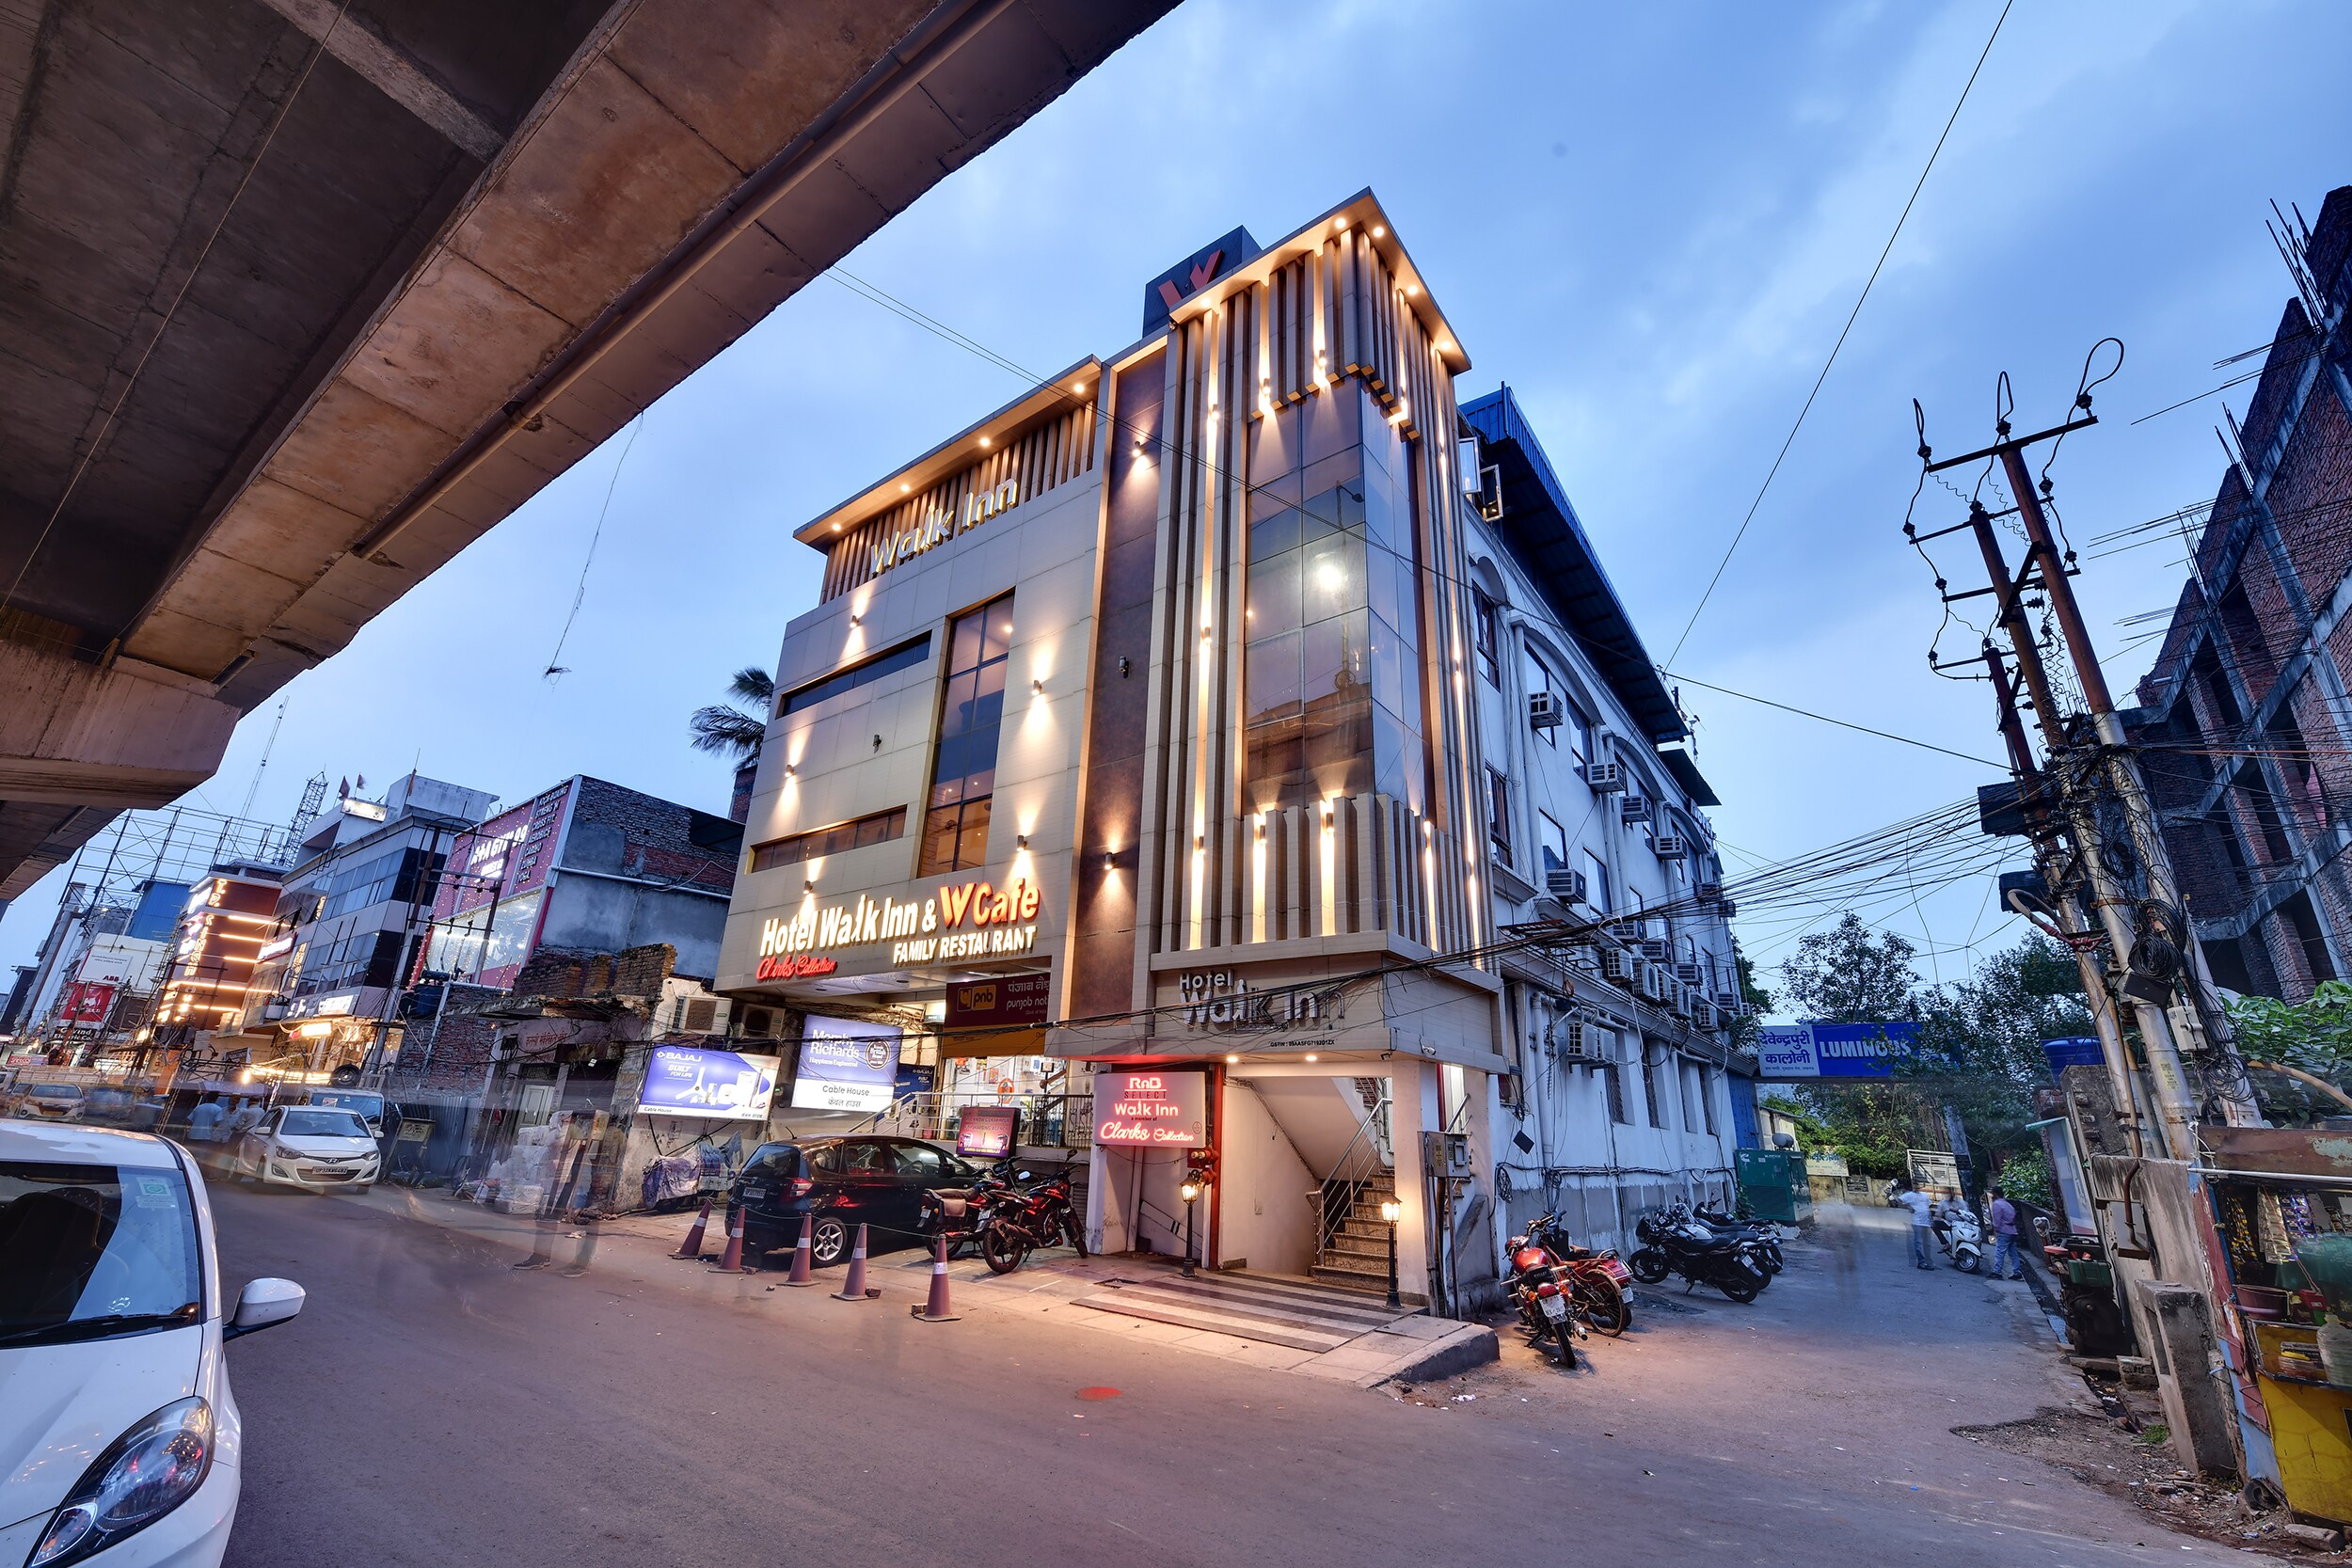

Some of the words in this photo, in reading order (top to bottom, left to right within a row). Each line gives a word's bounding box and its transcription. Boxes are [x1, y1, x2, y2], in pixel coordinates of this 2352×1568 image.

[871, 504, 954, 575] Walk
[961, 478, 1018, 530] Inn
[759, 910, 820, 958] Hotel
[818, 894, 882, 948] Walk
[881, 896, 919, 940] Inn
[921, 898, 938, 932] &
[893, 938, 939, 964] FAMILY
[939, 925, 1037, 958] RESTAURANT
[755, 954, 795, 981] Clarks
[795, 954, 837, 976] Collection
[1008, 980, 1033, 992] पंजाब
[1179, 969, 1234, 990] Hotel
[973, 989, 993, 1007] pnb
[1006, 996, 1033, 1011] punjab
[1180, 978, 1274, 1024] Walk
[1284, 990, 1345, 1021] Inn
[665, 1052, 703, 1062] BAJAJ
[810, 1042, 860, 1059] Richards
[1764, 1049, 1810, 1064] कालोनी
[809, 1056, 834, 1066] Happiness
[833, 1059, 858, 1068] Engineered
[822, 1085, 846, 1094] Cable
[846, 1085, 869, 1096] House
[1129, 1077, 1162, 1089] RnB
[1123, 1091, 1167, 1100] SELECT
[1114, 1101, 1152, 1117] Walk
[1155, 1103, 1179, 1117] Inn
[1100, 1121, 1150, 1141] Clarks
[1152, 1128, 1194, 1142] Collection
